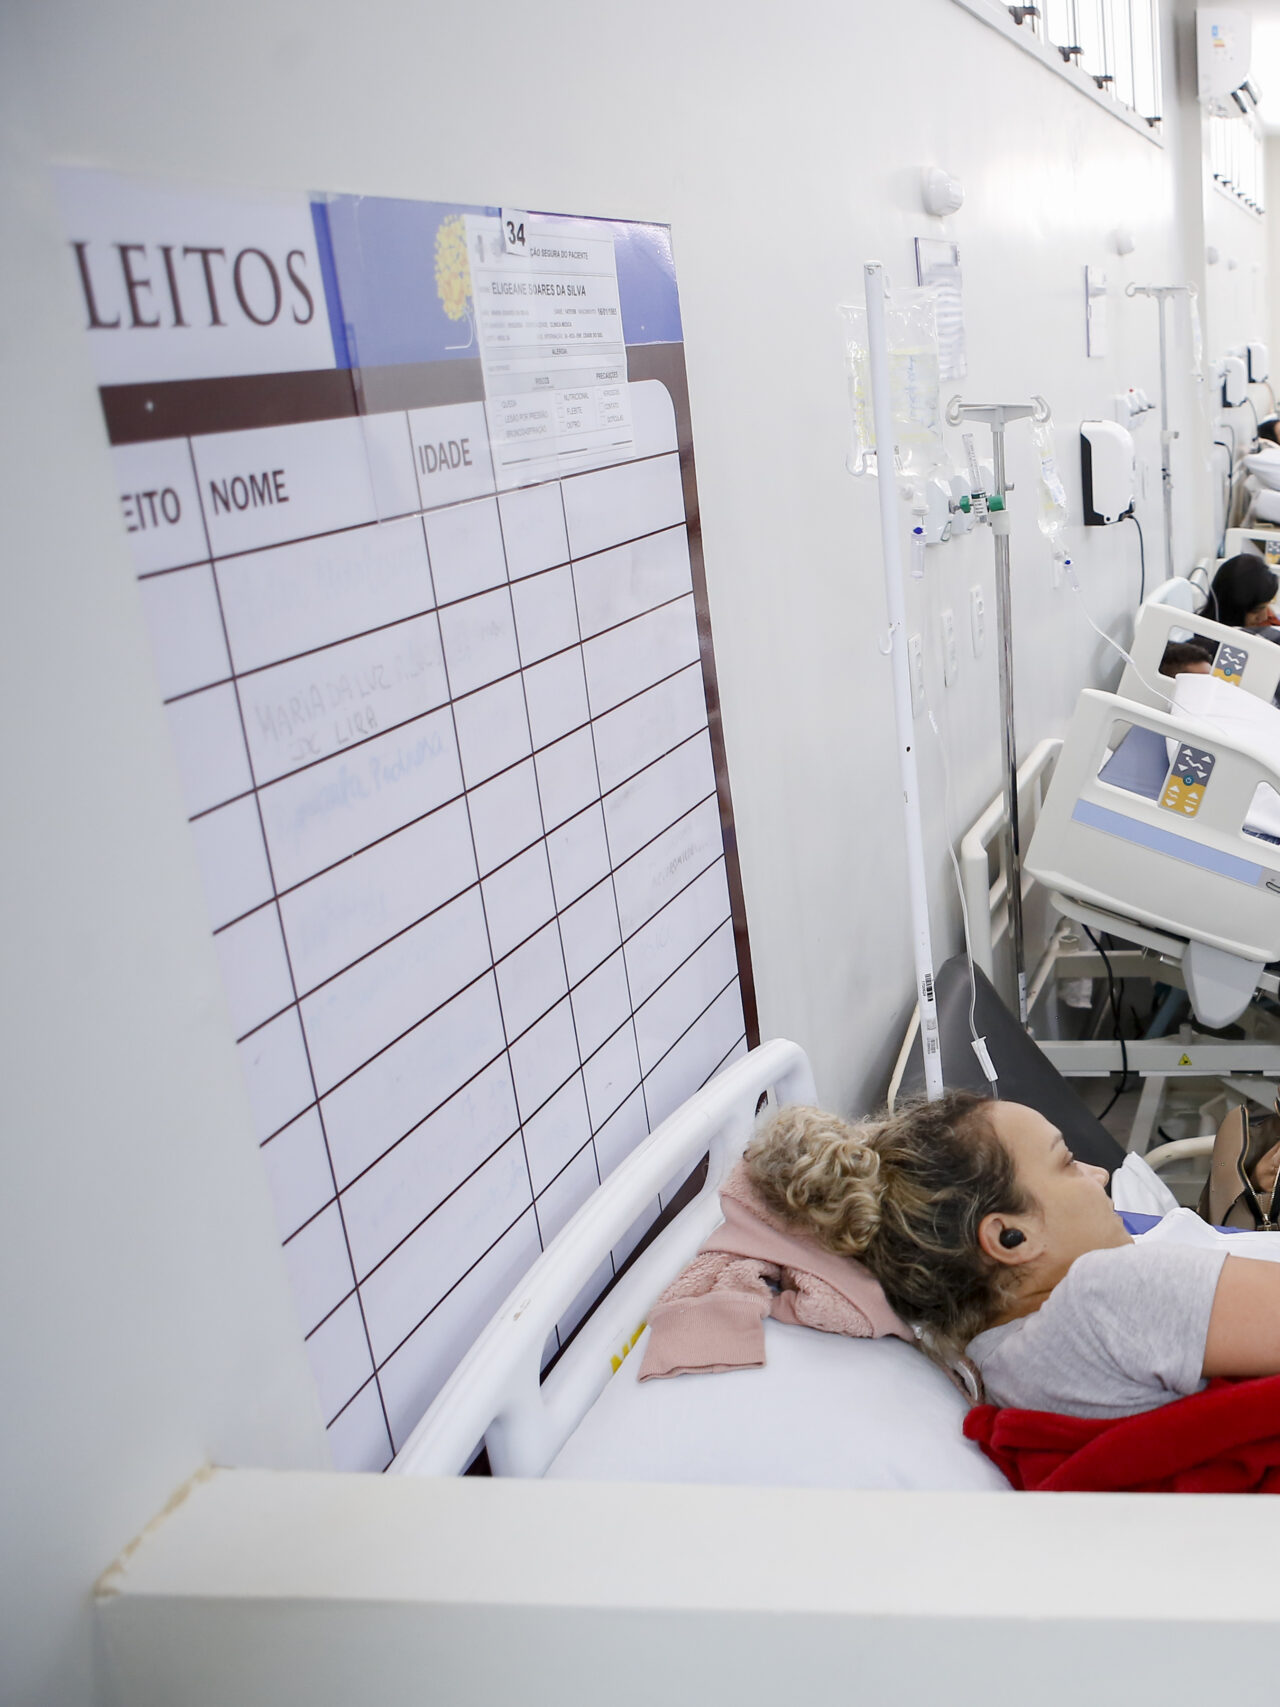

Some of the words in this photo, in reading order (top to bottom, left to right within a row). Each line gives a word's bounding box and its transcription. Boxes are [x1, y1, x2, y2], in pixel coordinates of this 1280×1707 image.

[506, 220, 526, 246] 34
[69, 240, 315, 330] LEITOS
[528, 283, 555, 296] SOARES
[556, 284, 566, 296] DA
[567, 284, 586, 296] SILVA
[209, 469, 290, 516] NOME
[418, 438, 473, 475] IDADE
